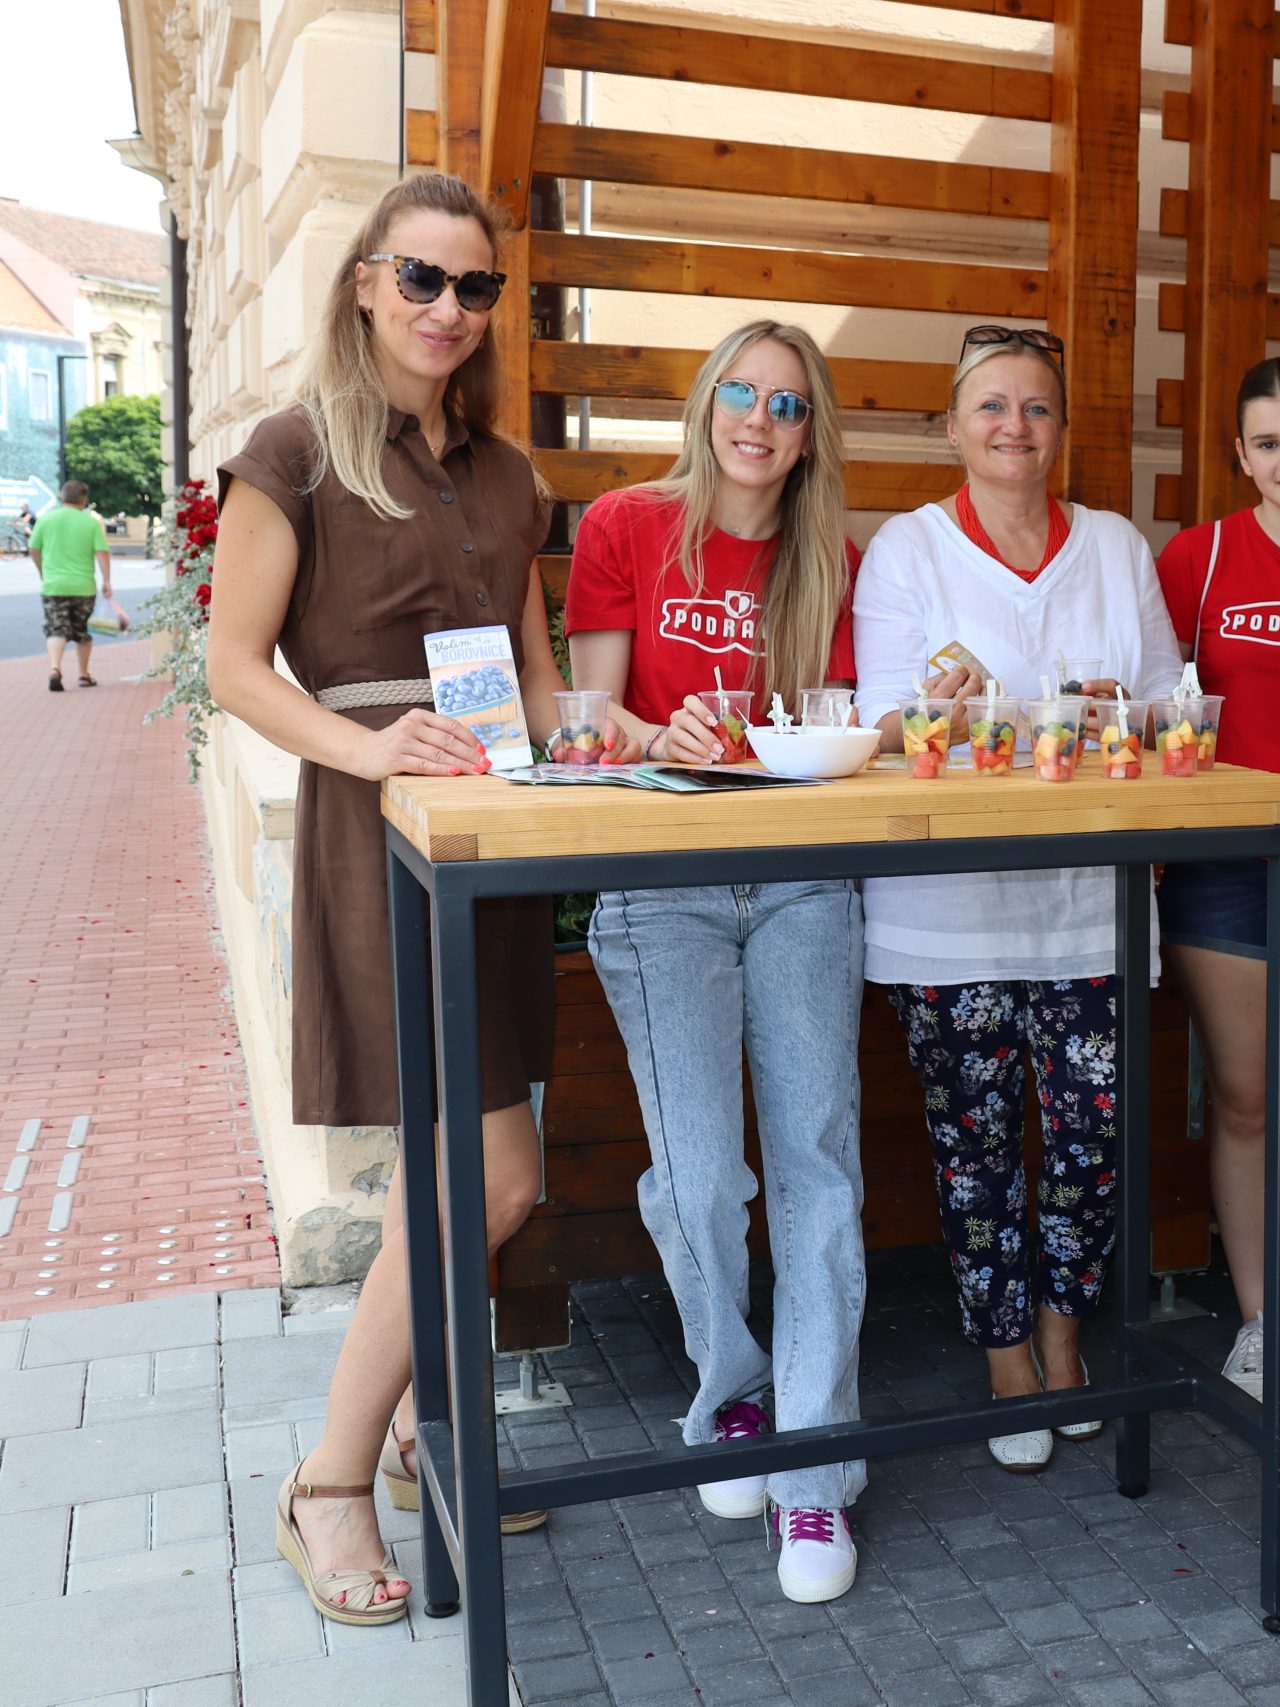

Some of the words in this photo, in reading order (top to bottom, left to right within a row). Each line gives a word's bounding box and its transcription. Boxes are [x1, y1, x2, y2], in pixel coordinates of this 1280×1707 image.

[674, 608, 766, 639] PODRA
[429, 639, 472, 653] Volim
[441, 644, 506, 663] BOROVNICE
